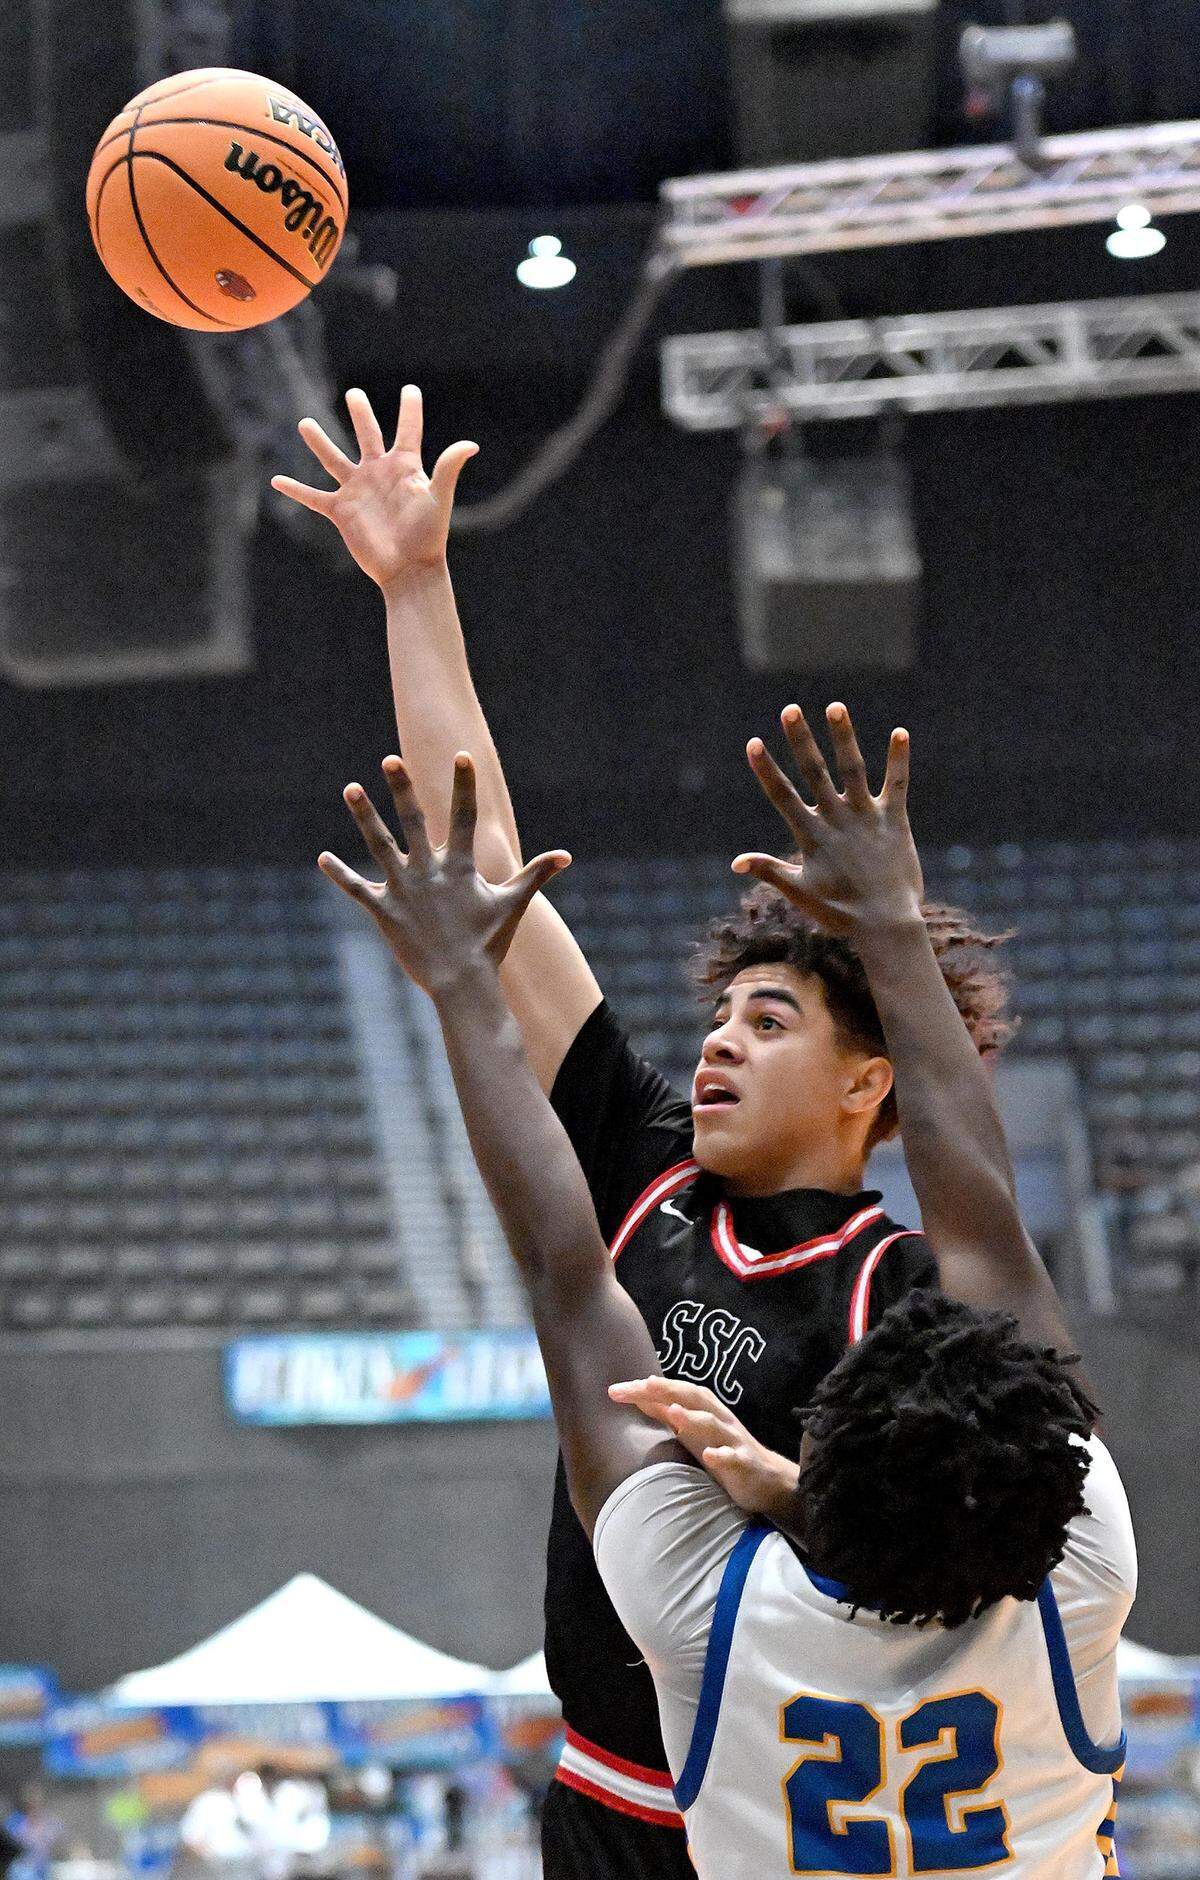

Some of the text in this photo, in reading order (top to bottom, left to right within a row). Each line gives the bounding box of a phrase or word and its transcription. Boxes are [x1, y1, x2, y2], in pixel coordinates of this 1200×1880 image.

[223, 140, 339, 270] Wilson
[655, 1300, 767, 1405] SSC
[778, 1686, 1017, 1879] 22
